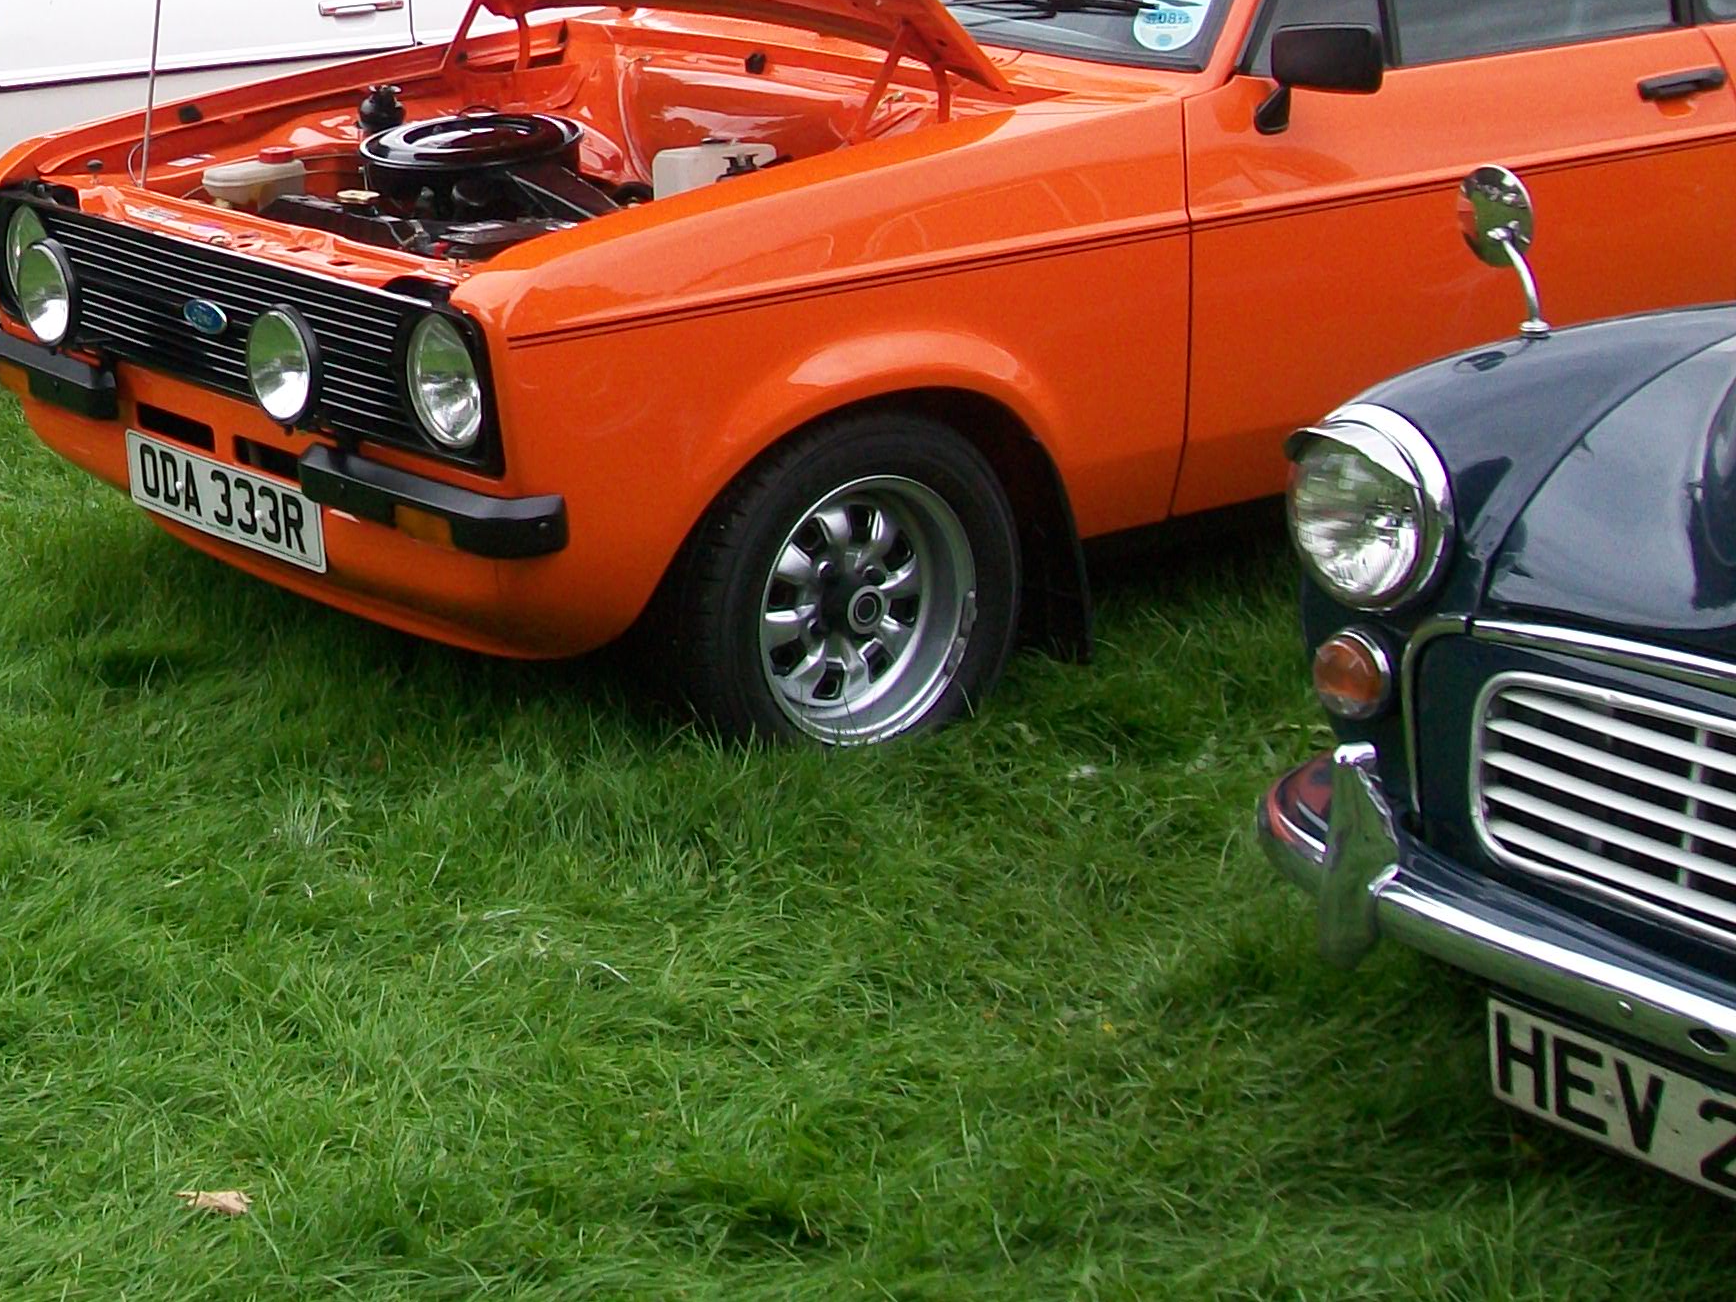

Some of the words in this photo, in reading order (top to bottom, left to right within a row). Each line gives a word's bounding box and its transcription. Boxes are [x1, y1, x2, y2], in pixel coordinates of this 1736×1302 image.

[139, 443, 203, 518] ODA
[210, 469, 307, 555] 333R
[1494, 1010, 1665, 1154] HEV
